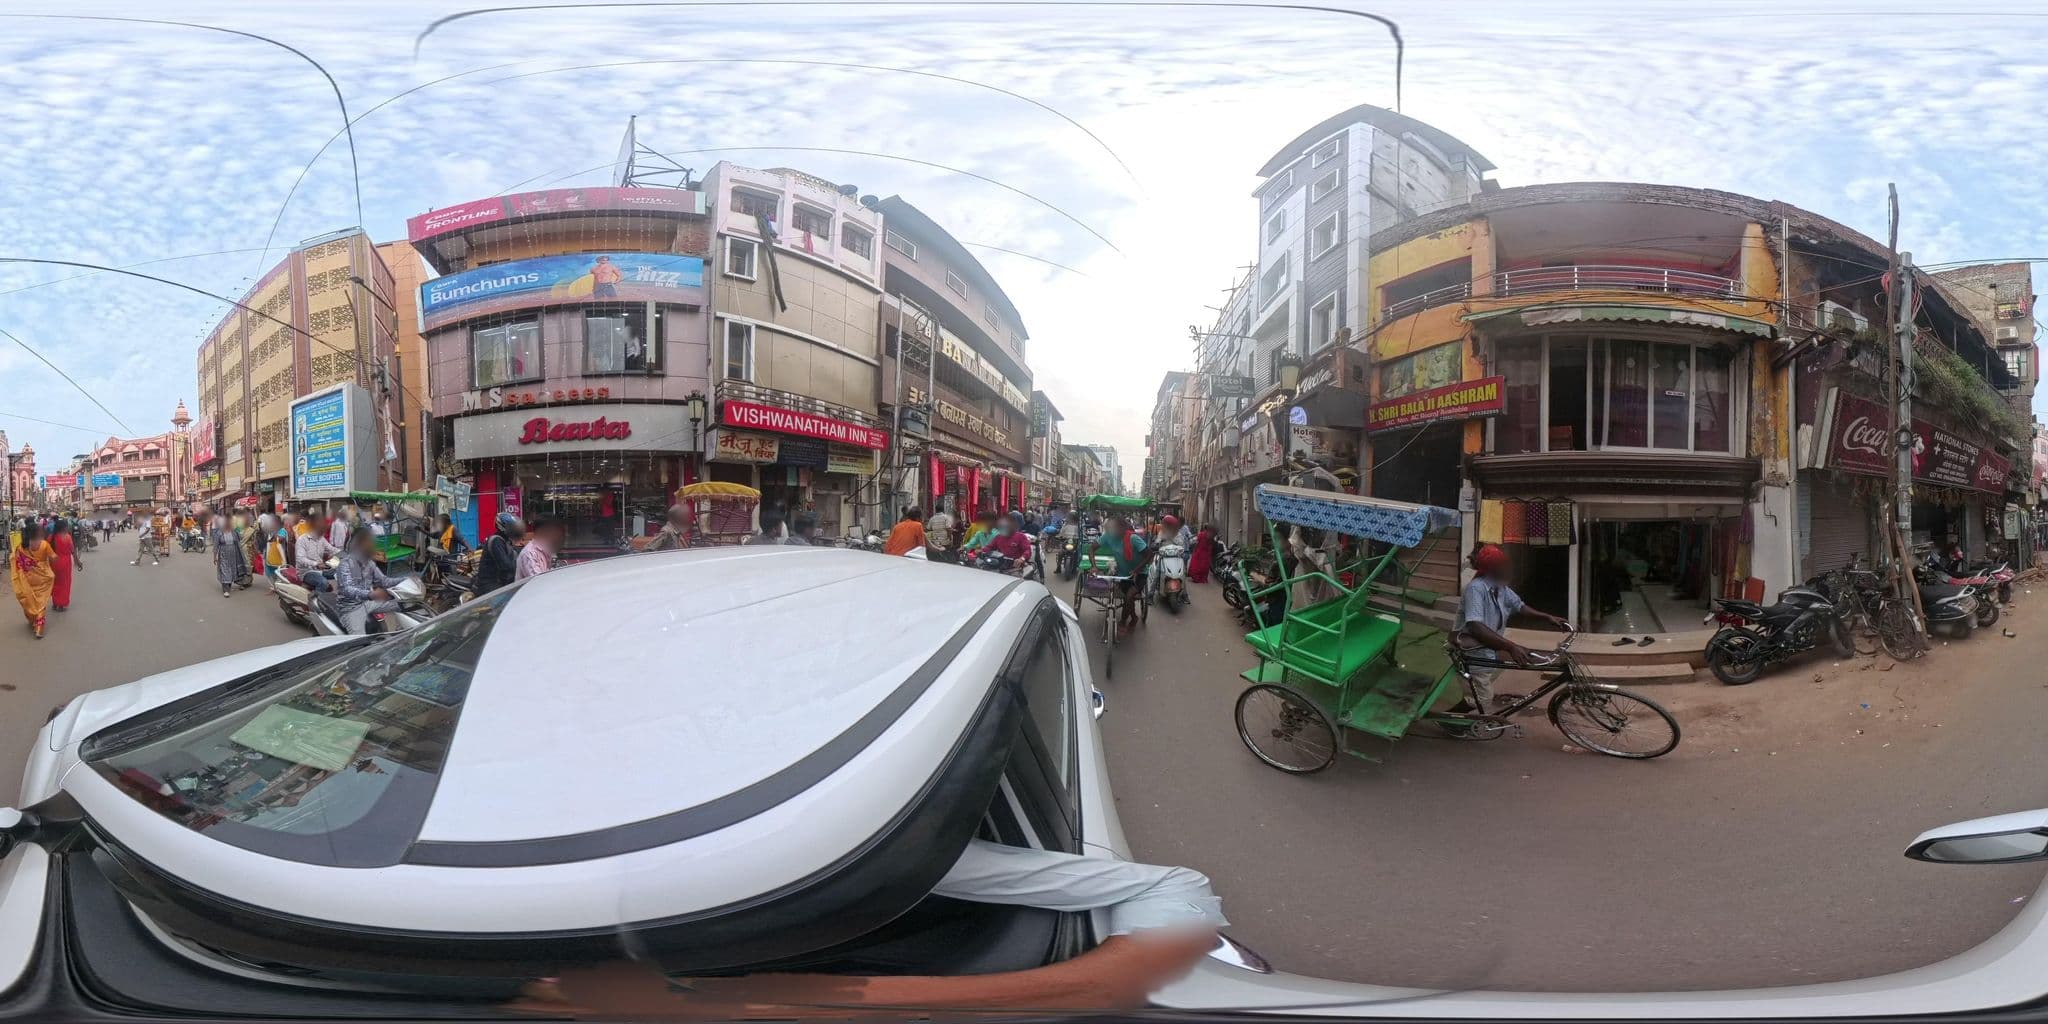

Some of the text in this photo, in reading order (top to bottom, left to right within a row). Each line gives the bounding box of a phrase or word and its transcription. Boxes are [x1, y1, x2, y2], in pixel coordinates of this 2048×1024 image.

[426, 208, 499, 231] FRONTLINE
[431, 272, 539, 304] Bumchums
[1378, 405, 1398, 422] SHRI
[1400, 401, 1424, 416] BALA
[1426, 398, 1435, 411] JI
[1437, 383, 1497, 409] AASHRAM
[732, 406, 846, 437] VISHWANATHAM
[849, 429, 867, 443] INN
[1934, 431, 1962, 450] NATIONAL
